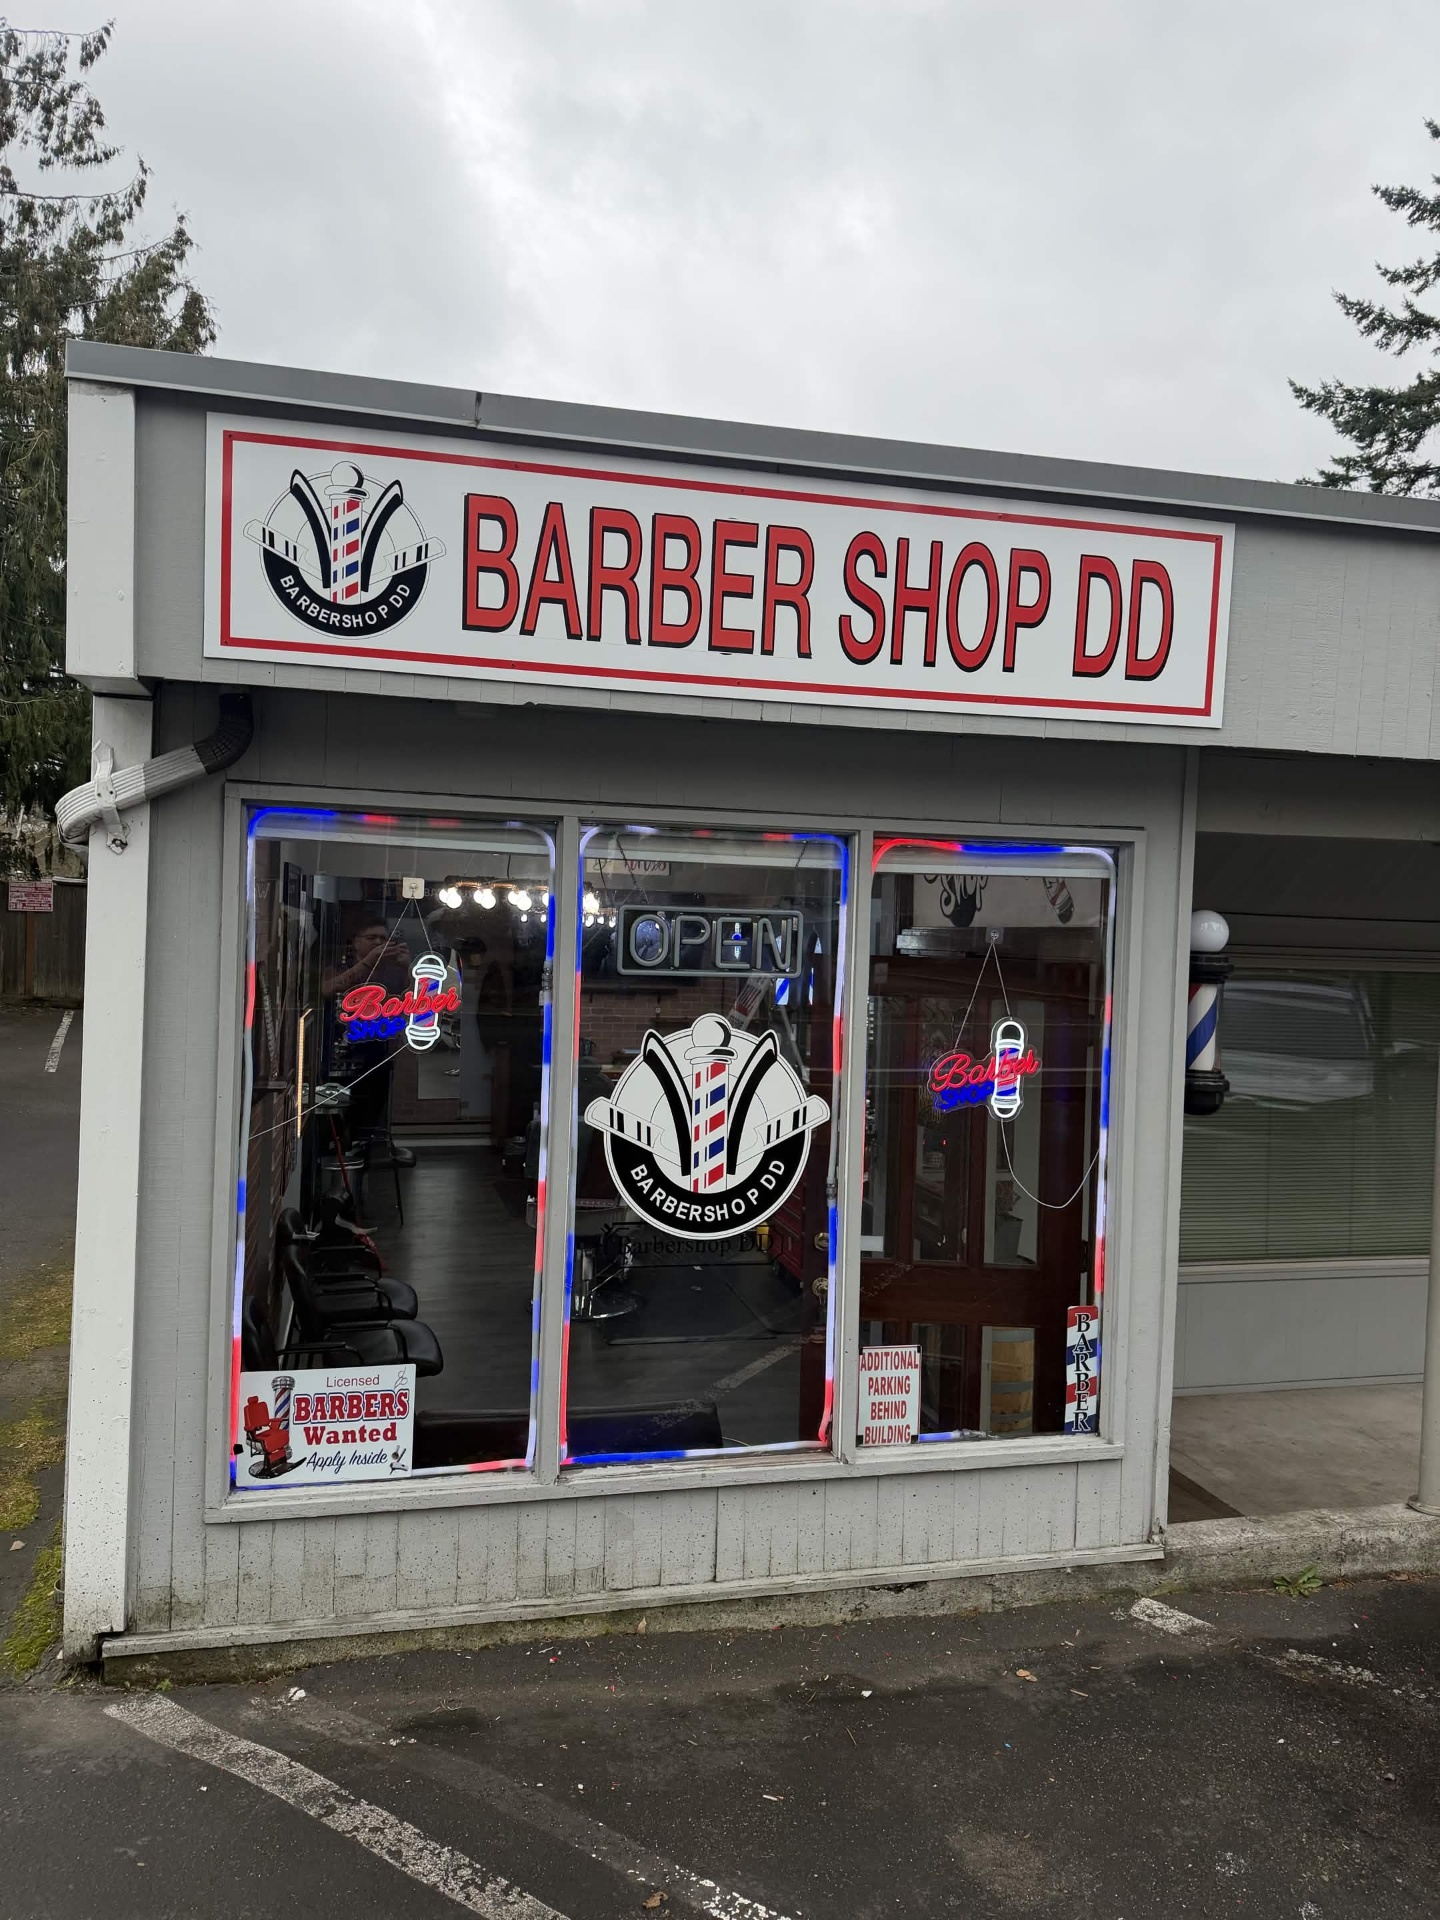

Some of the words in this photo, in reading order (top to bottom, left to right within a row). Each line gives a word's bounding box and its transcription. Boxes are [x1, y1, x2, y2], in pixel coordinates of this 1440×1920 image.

[280, 574, 389, 629] BARBERSHOP
[389, 583, 411, 610] DD
[462, 493, 815, 658] BARBER
[838, 531, 1051, 673] SHOP
[1072, 553, 1174, 681] DD
[629, 914, 792, 970] OPEN
[339, 979, 461, 1022] Barber
[347, 1017, 406, 1041] SHOP
[931, 1048, 1039, 1091] Barber
[937, 1081, 995, 1110] SHOP
[630, 1163, 761, 1223] BARBERSHOP
[759, 1159, 785, 1190] DD
[860, 1349, 919, 1372] ADDITIONAL
[1072, 1312, 1093, 1432] BARBER
[326, 1374, 380, 1388] Licensed
[867, 1375, 911, 1396] PARKING
[294, 1389, 409, 1424] BARBERS
[870, 1401, 907, 1421] BEHIND
[303, 1422, 398, 1446] Wanted
[864, 1424, 911, 1445] BUILDING
[306, 1451, 347, 1475] Apply
[348, 1448, 388, 1466] Inside
